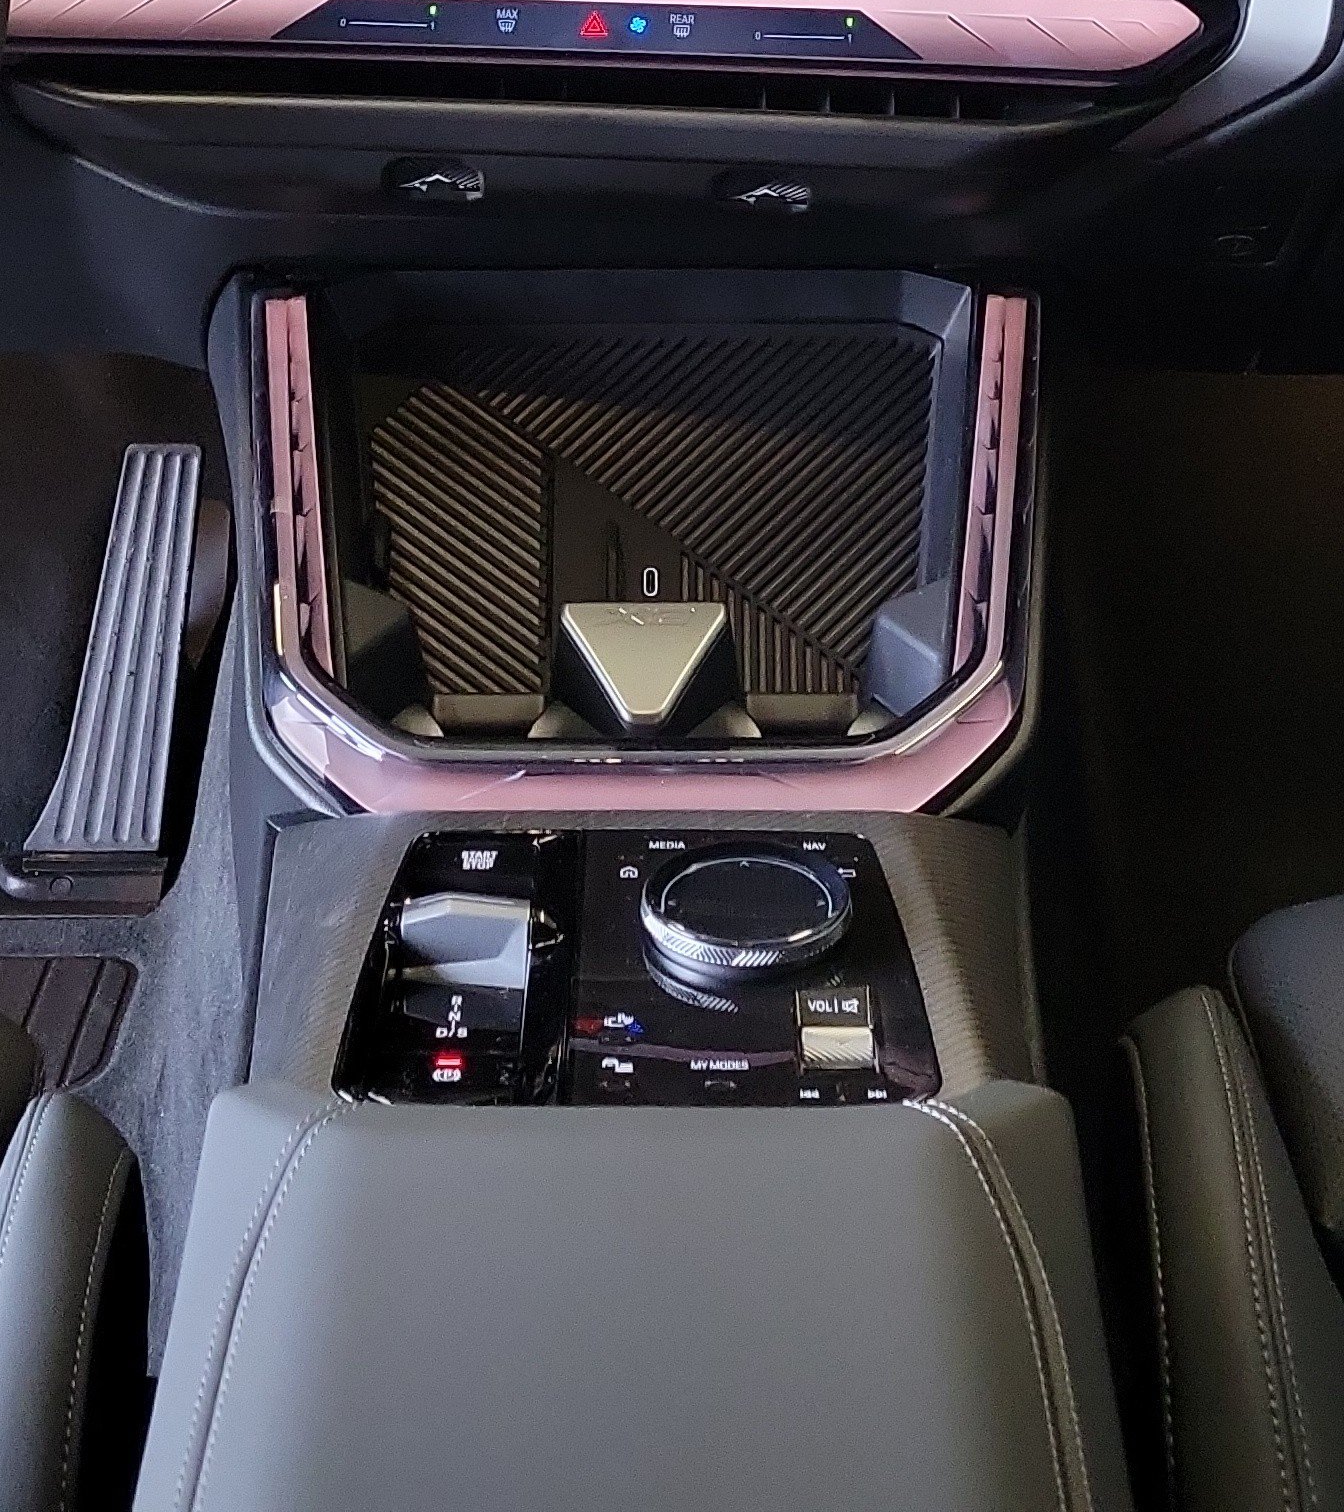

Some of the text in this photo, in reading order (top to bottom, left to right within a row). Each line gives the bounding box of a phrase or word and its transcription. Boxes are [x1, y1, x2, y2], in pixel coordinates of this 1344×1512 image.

[496, 8, 518, 19] MAX
[670, 13, 694, 24] REAR
[649, 841, 686, 850] MEDIA
[803, 841, 826, 851] NAV
[808, 998, 832, 1013] VOL
[709, 1059, 750, 1071] MODES
